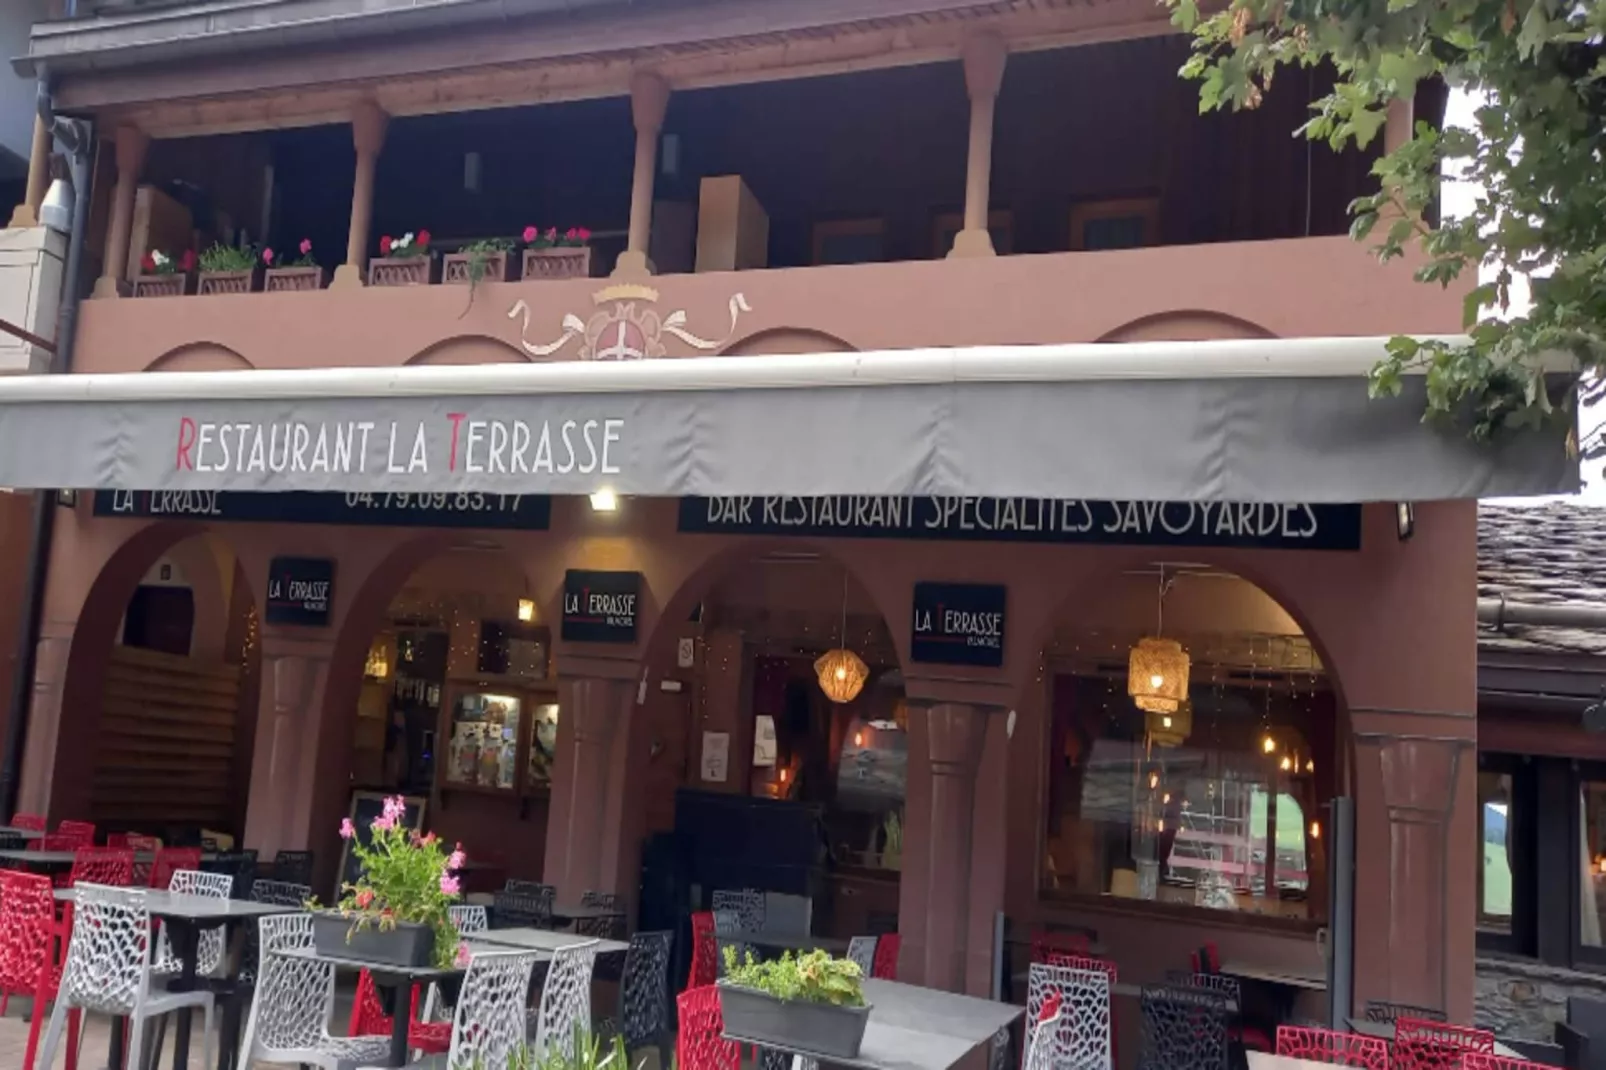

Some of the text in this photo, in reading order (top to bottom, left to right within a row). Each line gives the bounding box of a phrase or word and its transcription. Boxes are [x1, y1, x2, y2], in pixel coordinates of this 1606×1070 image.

[176, 413, 625, 475] RESTAURANT LA TERRASSE
[112, 489, 134, 512] LA
[762, 496, 914, 528] RESTAURANT
[1102, 500, 1318, 538] SAVOYARDES
[268, 580, 281, 598] LA
[564, 587, 636, 616] LA TERRASSE
[915, 602, 1002, 636] LA TERRASSE
